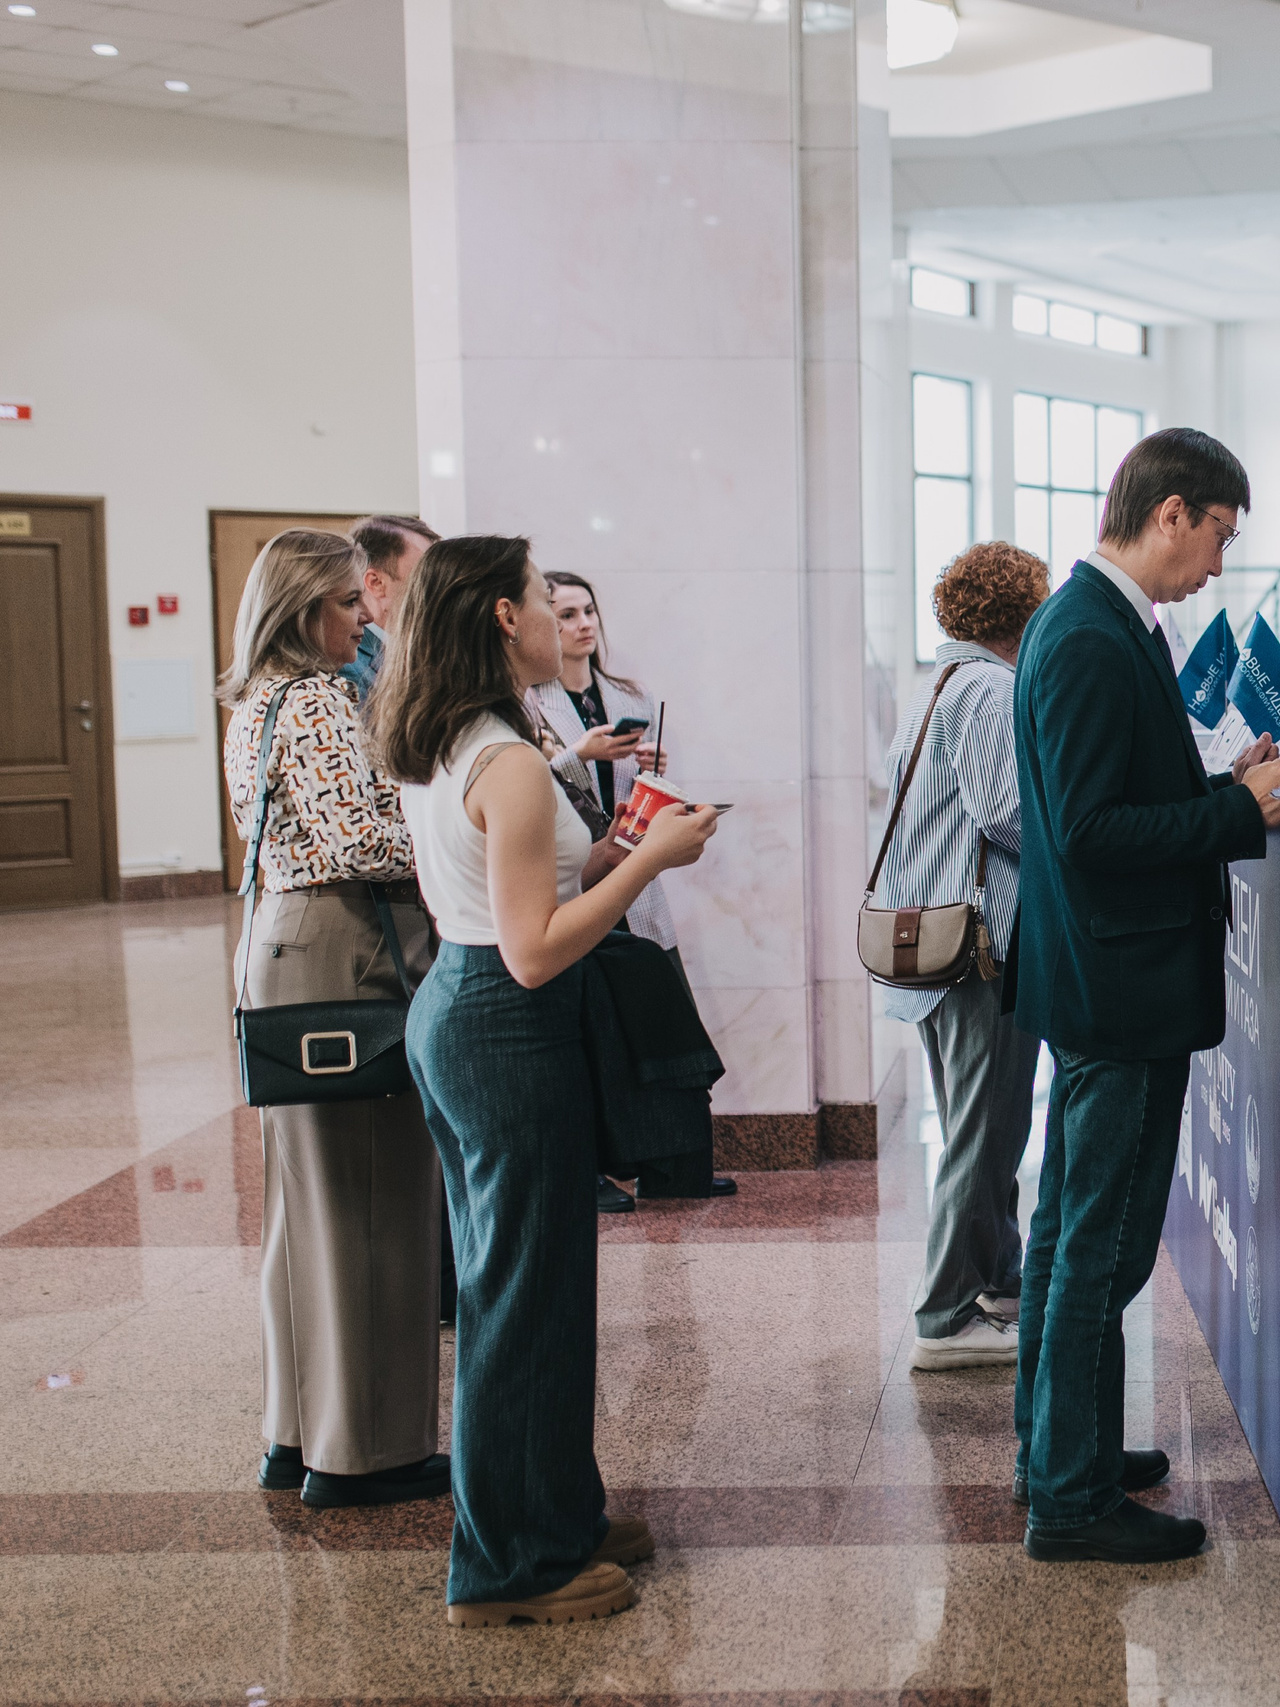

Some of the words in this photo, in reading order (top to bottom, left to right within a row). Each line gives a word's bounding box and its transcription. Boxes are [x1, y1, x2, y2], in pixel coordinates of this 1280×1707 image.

[1239, 647, 1271, 688] ОВЫЕ
[1226, 874, 1260, 988] ДЕИ
[1241, 986, 1261, 1050] ГАЗА
